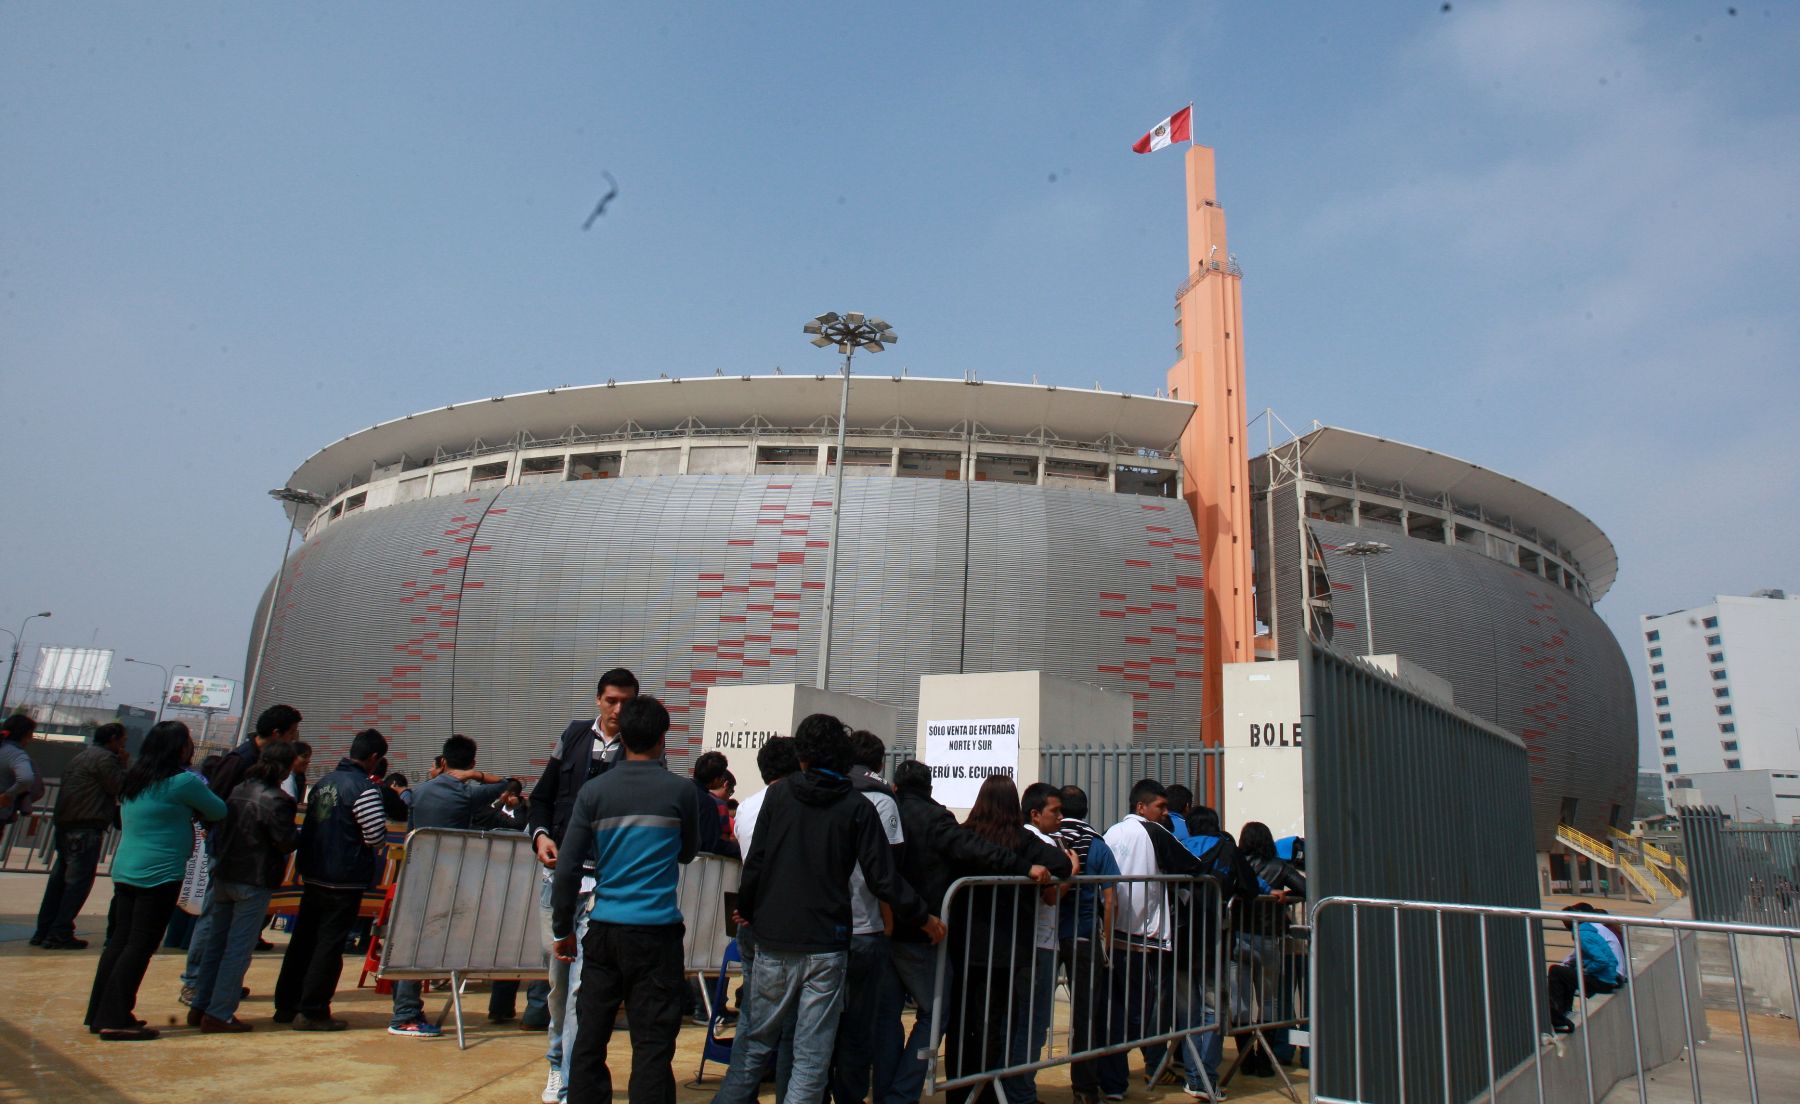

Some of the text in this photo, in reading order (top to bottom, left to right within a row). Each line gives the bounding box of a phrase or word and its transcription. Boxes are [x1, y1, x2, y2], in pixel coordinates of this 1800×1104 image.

[928, 724, 1016, 736] SÓLO VENTA DE ENTRADAS
[1249, 722, 1302, 748] BOLE
[949, 739, 993, 751] NORTE Y SUR
[952, 766, 967, 779] VS.
[969, 766, 1014, 779] ECUADOR
